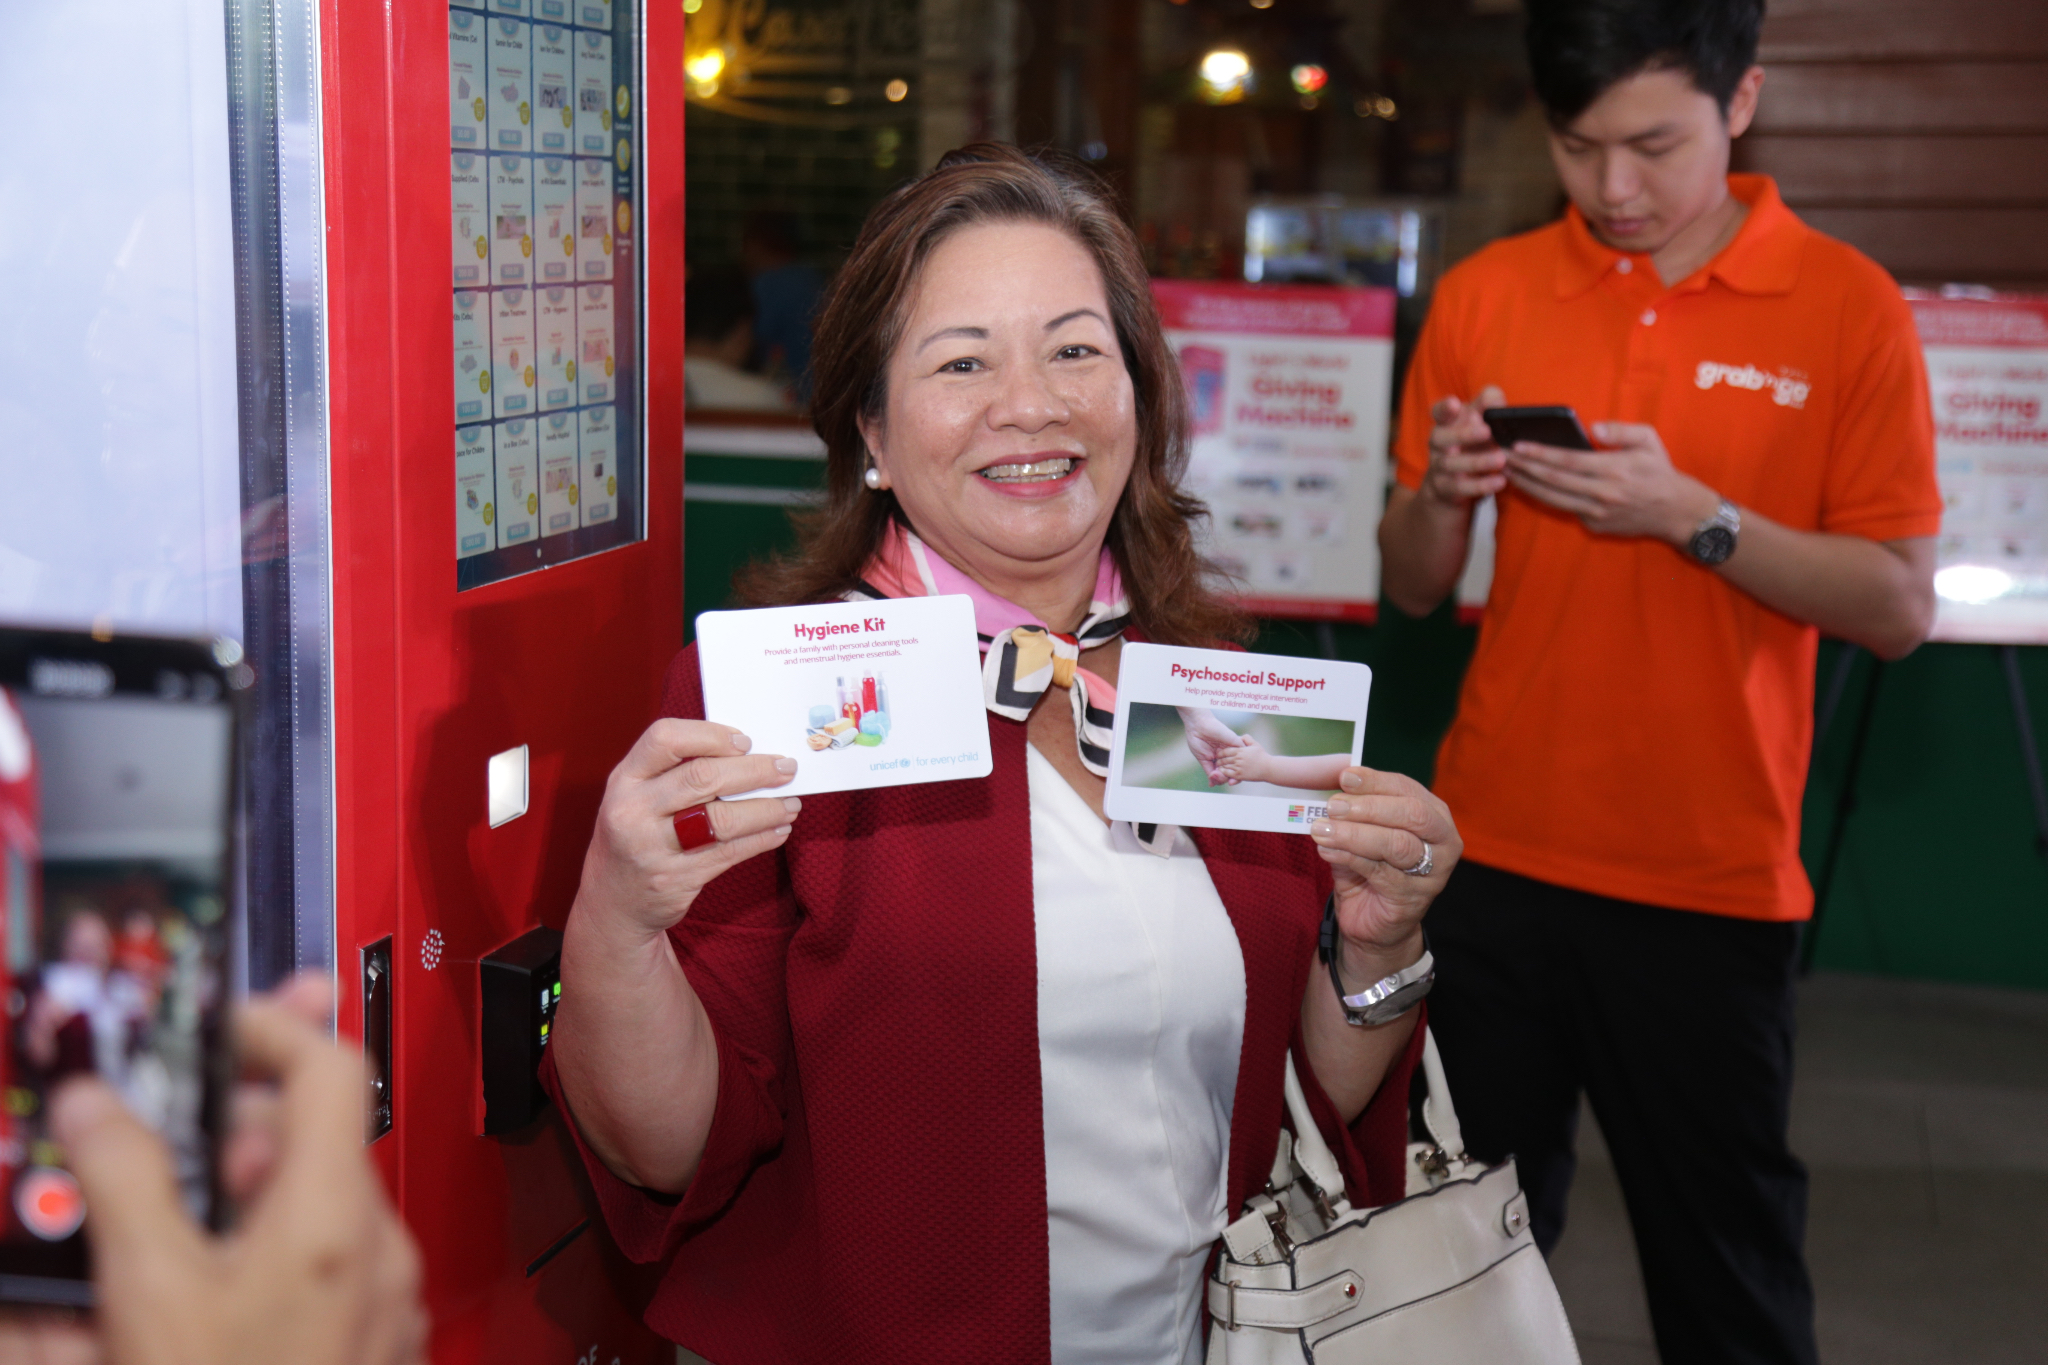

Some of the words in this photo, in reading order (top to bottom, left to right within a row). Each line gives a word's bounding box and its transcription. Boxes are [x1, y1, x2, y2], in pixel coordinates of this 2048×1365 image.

[1694, 360, 1765, 391] grab
[794, 621, 860, 642] Hygiene
[863, 617, 886, 632] Kit
[764, 647, 792, 657] Provide
[799, 645, 821, 655] family
[822, 643, 838, 652] with
[839, 641, 871, 652] personal
[871, 638, 901, 649] cleaning
[901, 637, 919, 645] tools
[784, 656, 799, 666] and
[799, 653, 837, 664] menstrual
[837, 651, 865, 662] hygiene
[866, 648, 903, 659] essentials.
[1170, 663, 1265, 685] Psychosocial
[1267, 672, 1326, 692] Support
[1185, 686, 1199, 697] Help
[1201, 687, 1225, 698] provide
[1226, 690, 1269, 702] psychological
[1269, 693, 1308, 704] intervention
[1210, 697, 1220, 706] for
[1220, 698, 1247, 708] children
[1247, 701, 1260, 710] and
[1261, 702, 1281, 712] youth.
[869, 757, 899, 771] unicef
[916, 756, 928, 767] for
[930, 755, 957, 766] every
[957, 751, 979, 764] child
